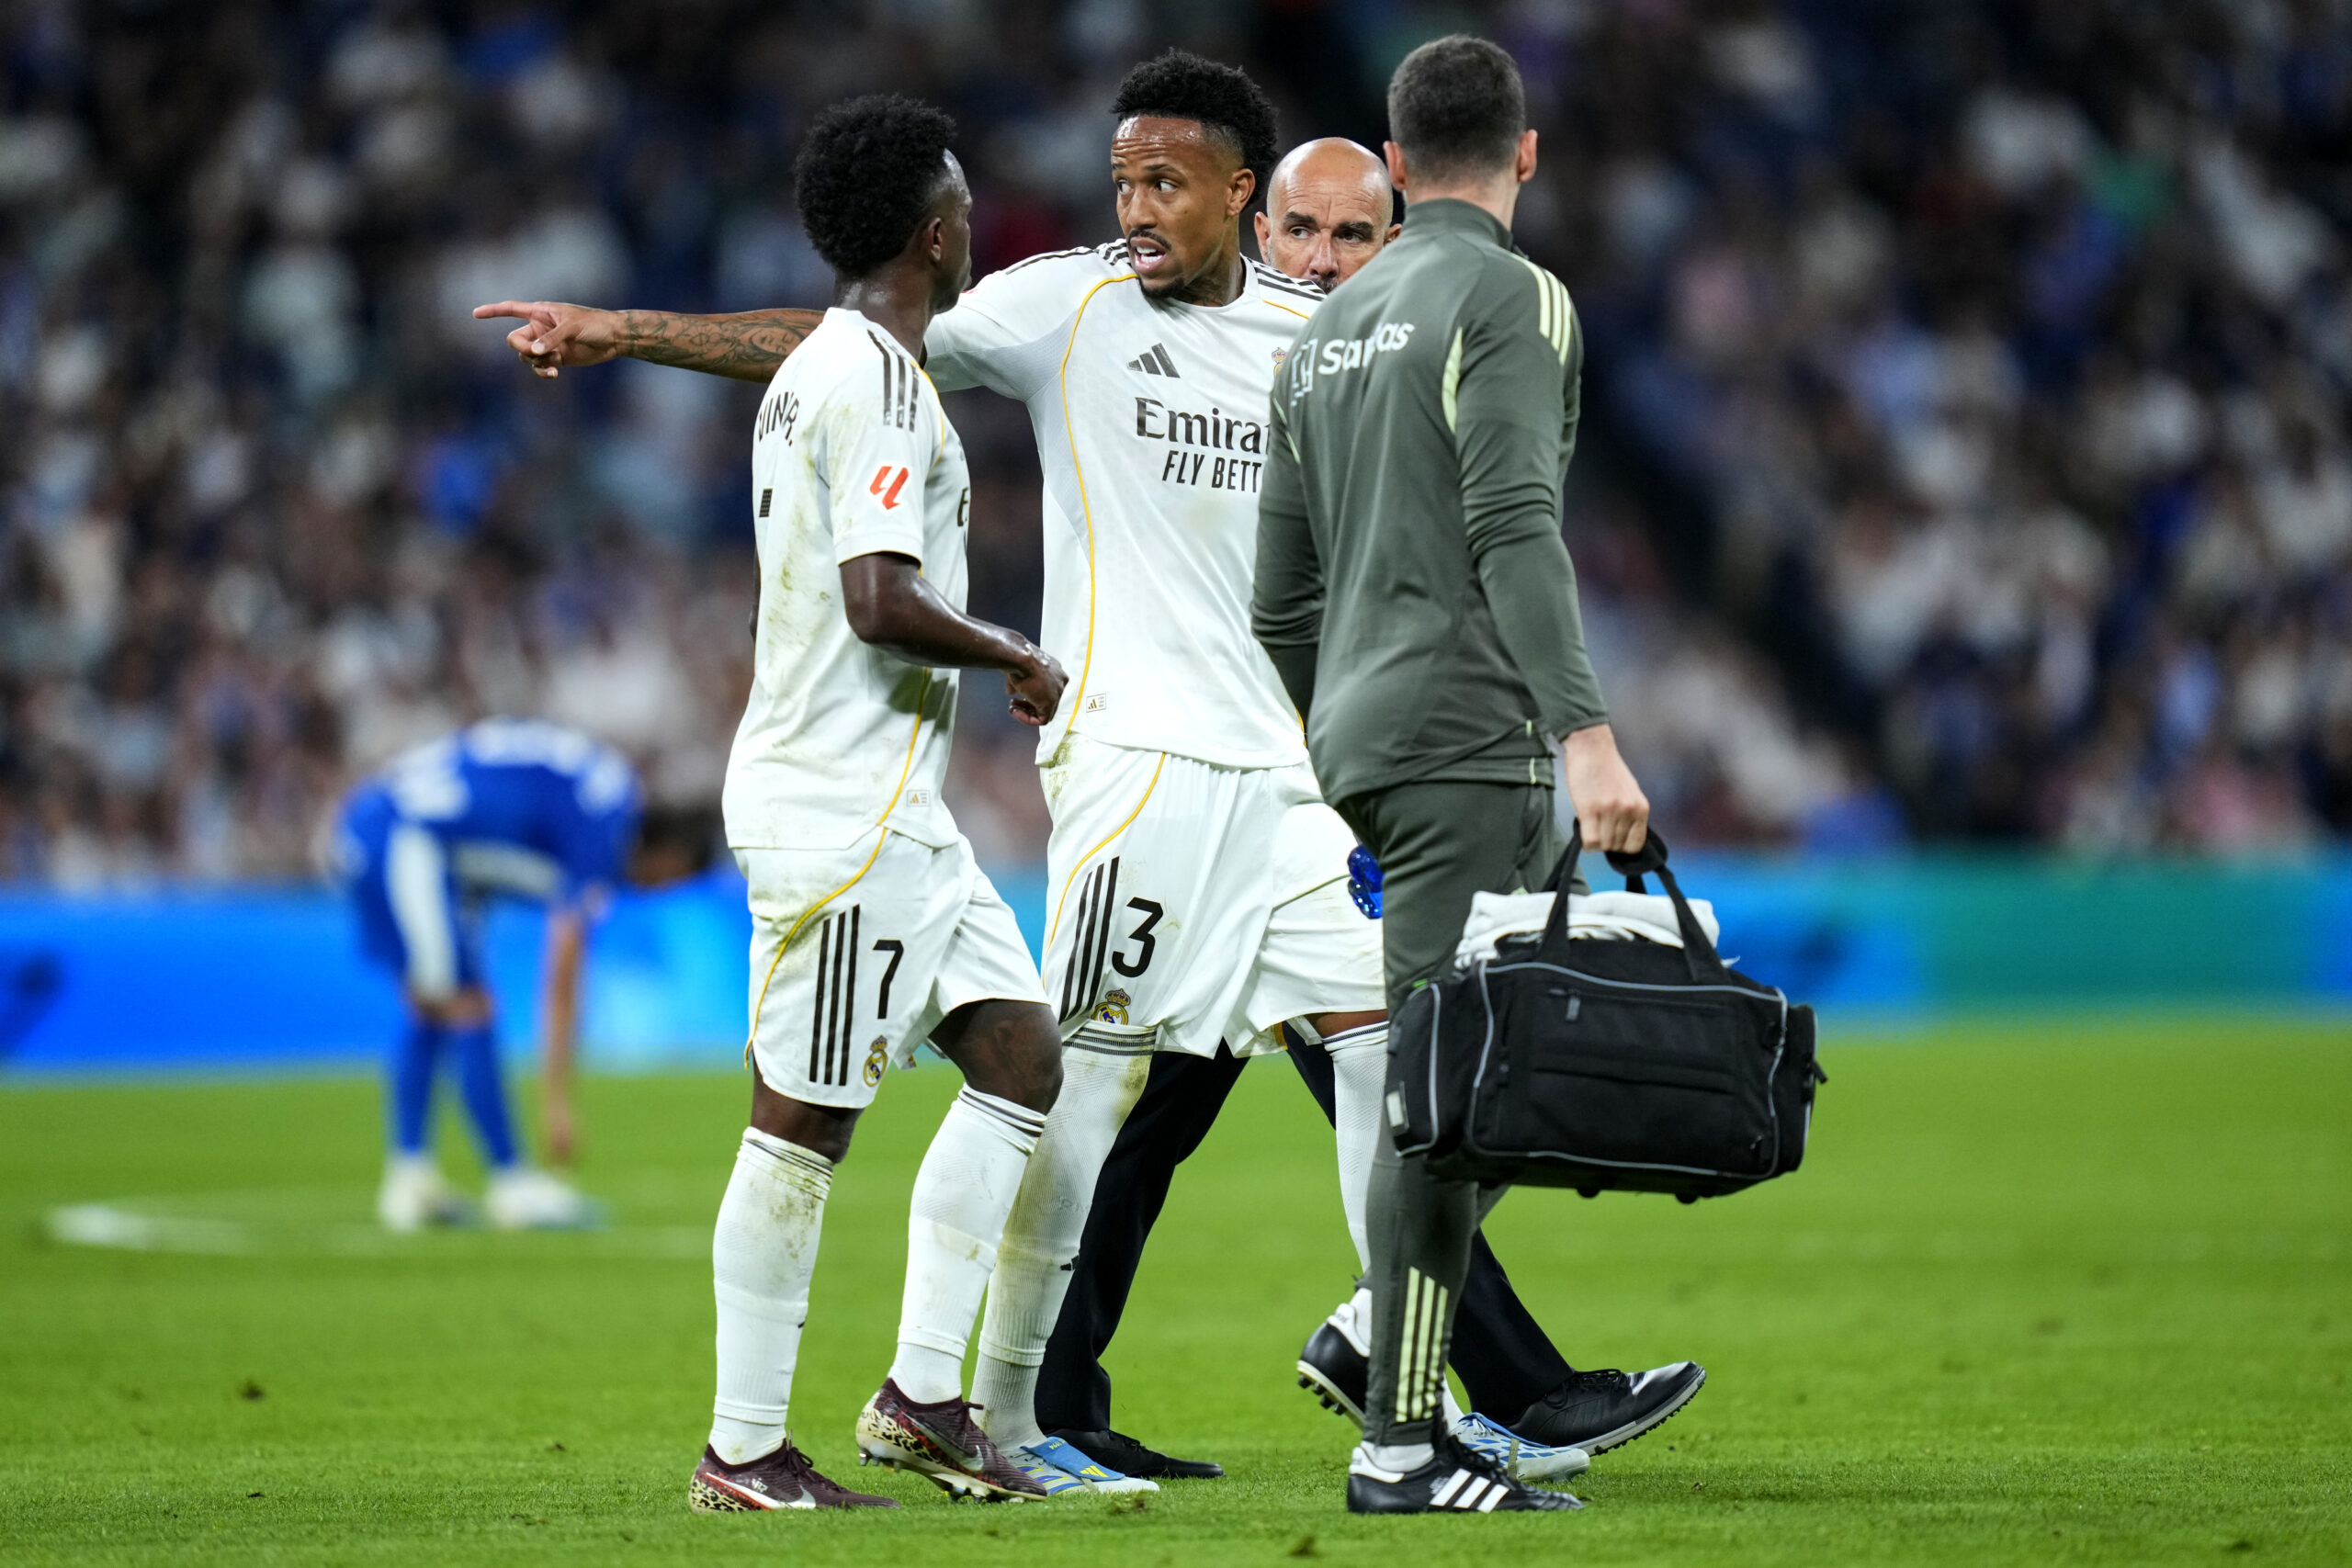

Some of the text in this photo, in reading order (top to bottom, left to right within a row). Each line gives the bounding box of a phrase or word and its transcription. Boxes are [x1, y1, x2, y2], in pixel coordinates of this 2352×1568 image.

[1317, 322, 1415, 376] Saas
[1162, 450, 1205, 486] FLY
[1112, 897, 1163, 978] 3
[873, 939, 904, 1020] 7
